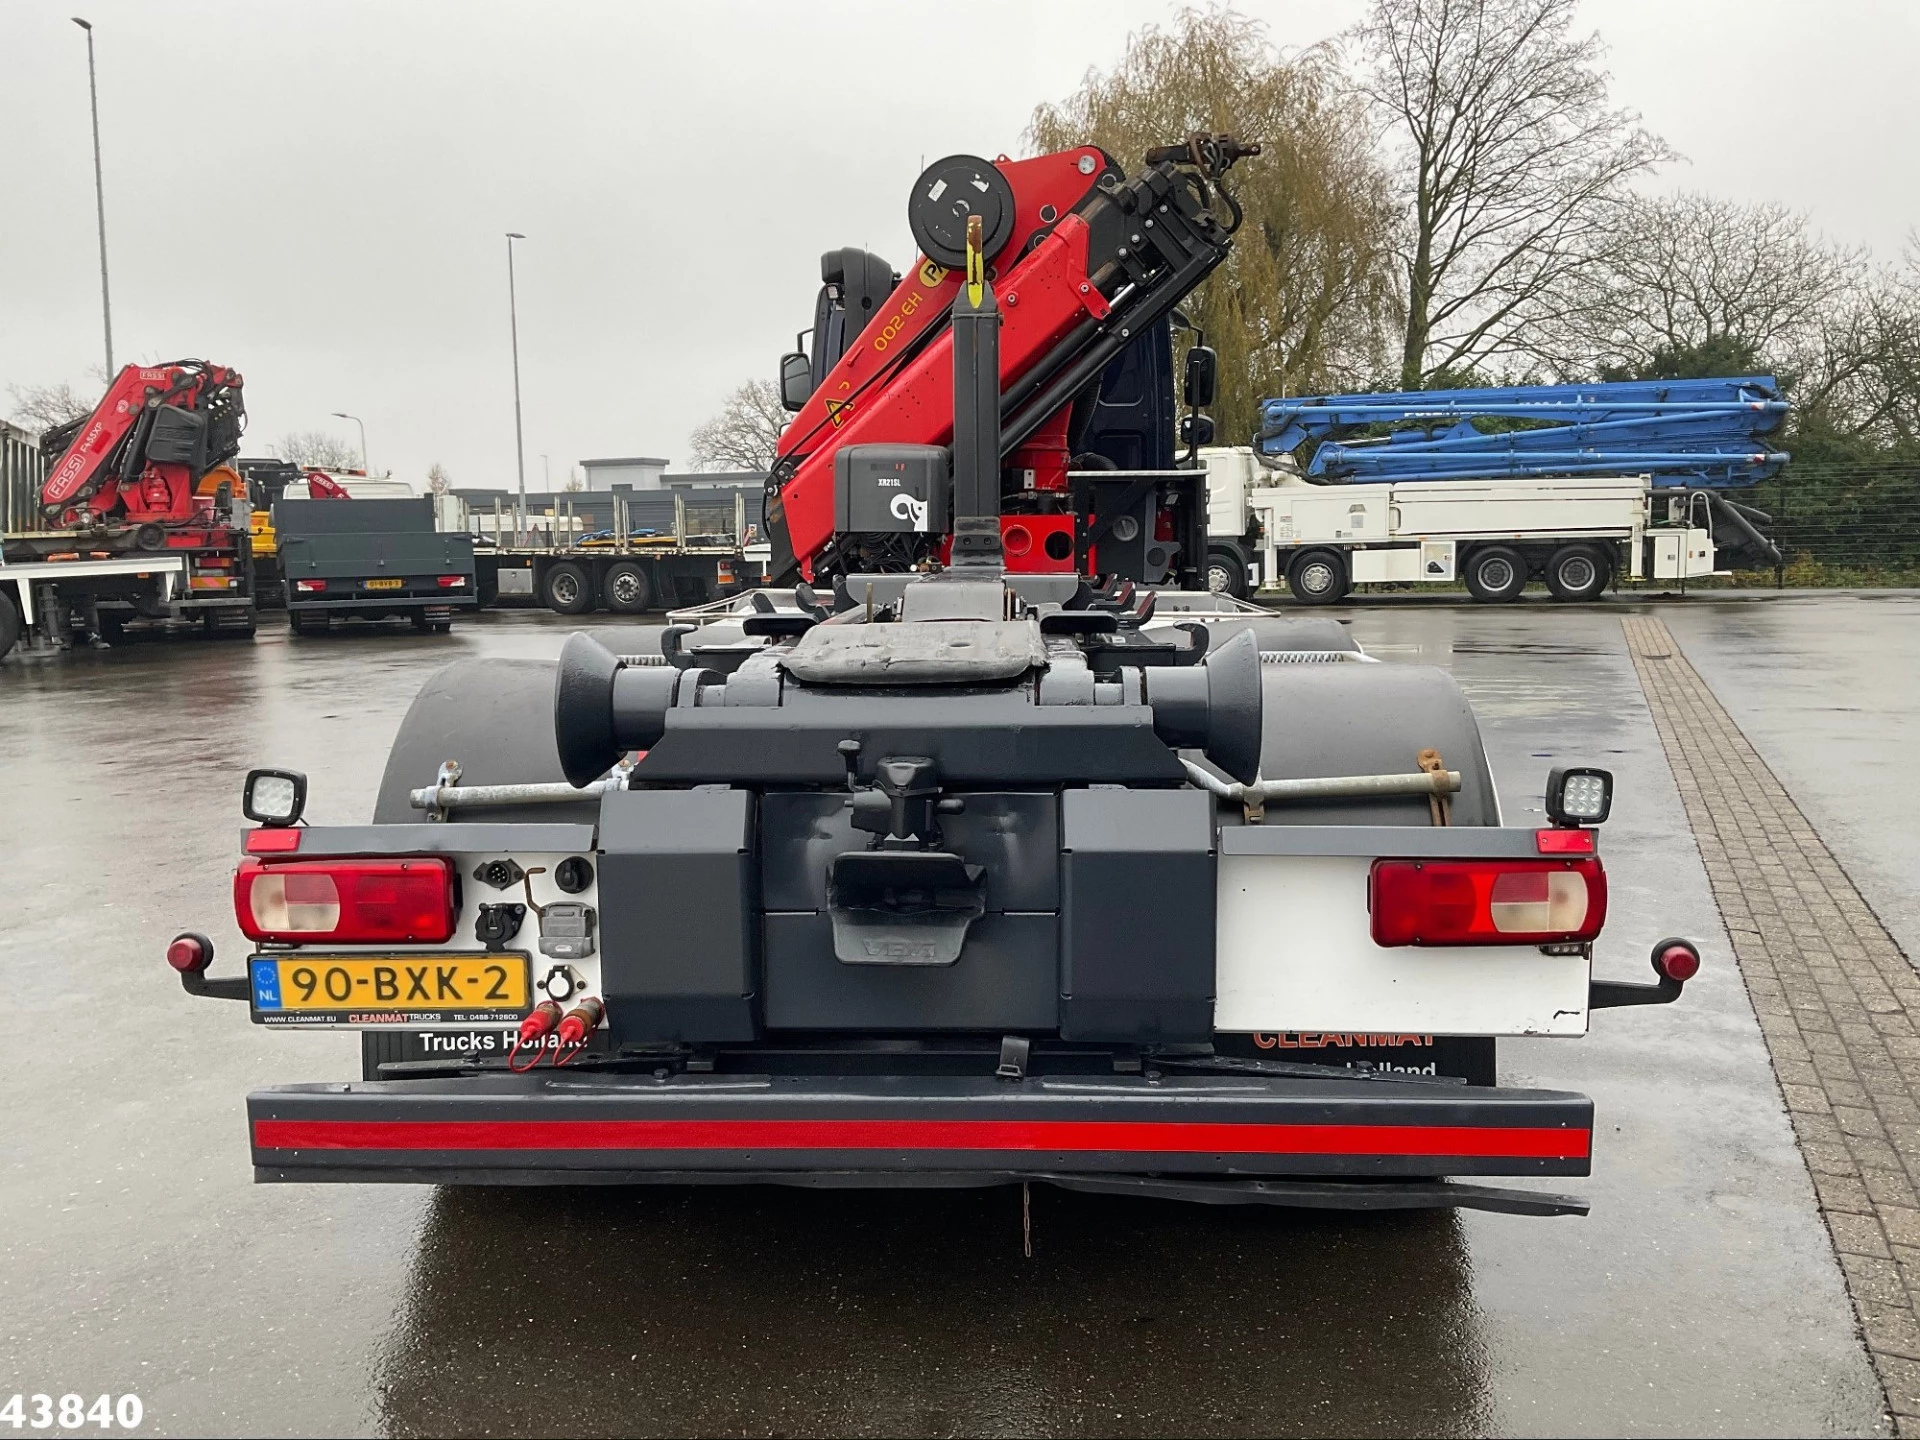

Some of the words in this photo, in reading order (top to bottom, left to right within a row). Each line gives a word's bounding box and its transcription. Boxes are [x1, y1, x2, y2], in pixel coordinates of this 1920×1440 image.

[51, 457, 84, 497] FASSI
[259, 990, 277, 1001] NL
[291, 965, 510, 1002] 90-BXK-2
[419, 1032, 495, 1052] Trucks
